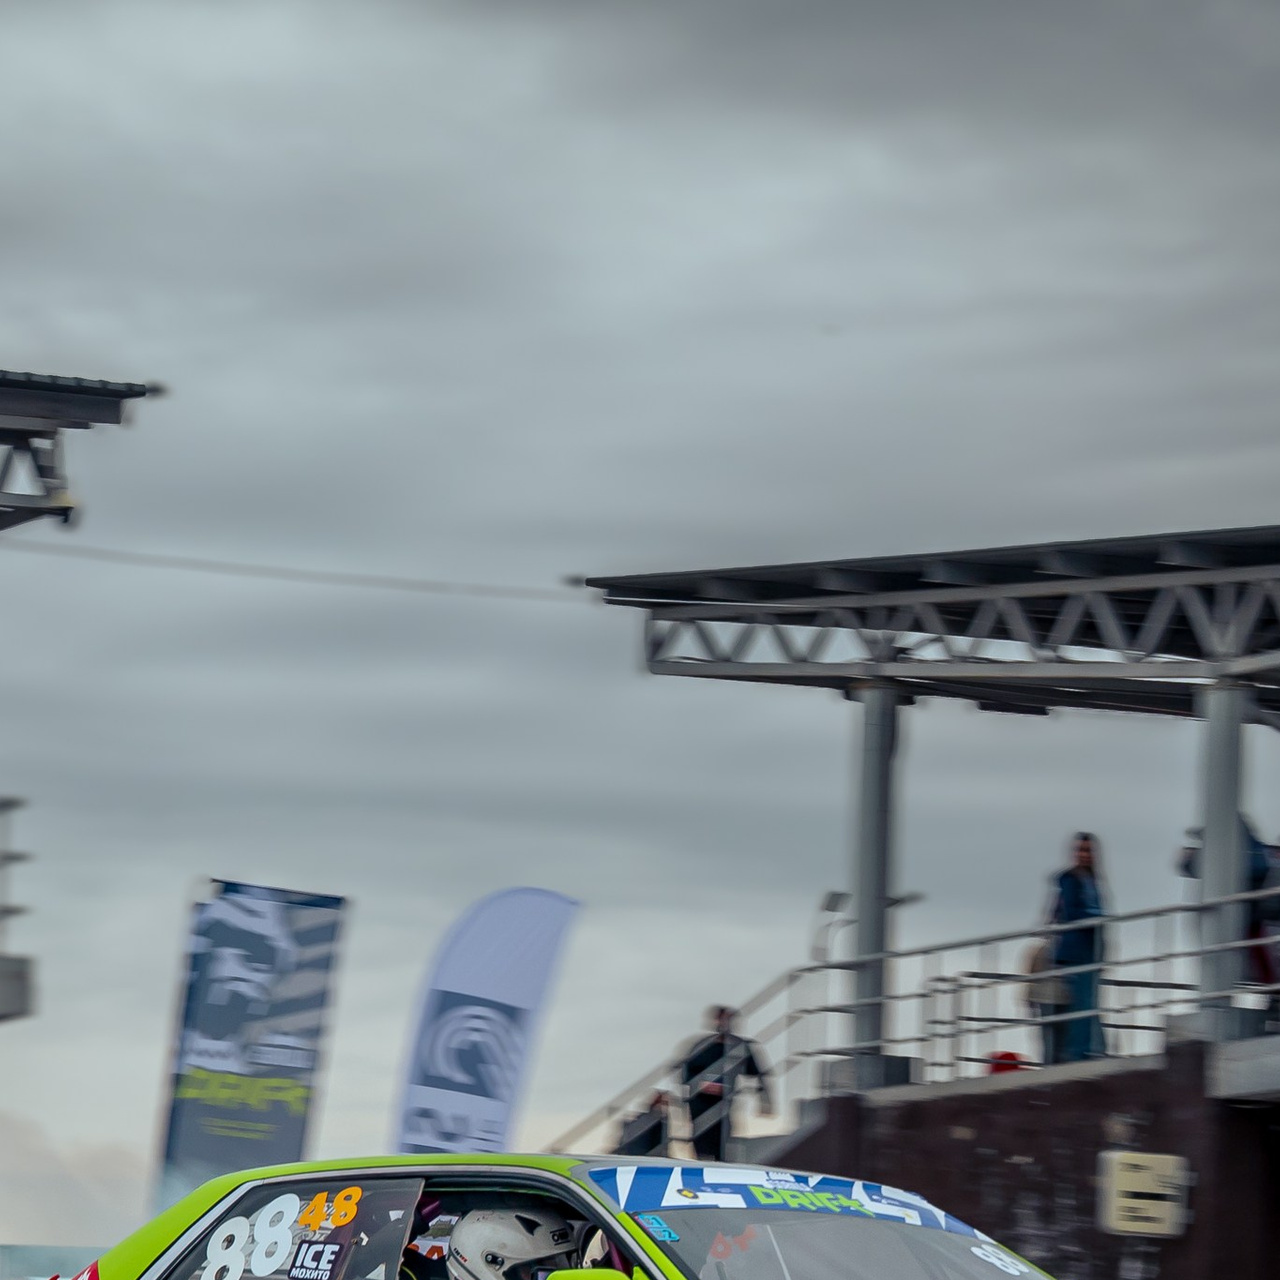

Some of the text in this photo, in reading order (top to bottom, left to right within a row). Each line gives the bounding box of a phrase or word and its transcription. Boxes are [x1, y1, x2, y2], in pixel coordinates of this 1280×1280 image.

[298, 1186, 363, 1231] 48
[748, 1184, 875, 1217] DRIFT
[295, 1243, 341, 1270] ICE
